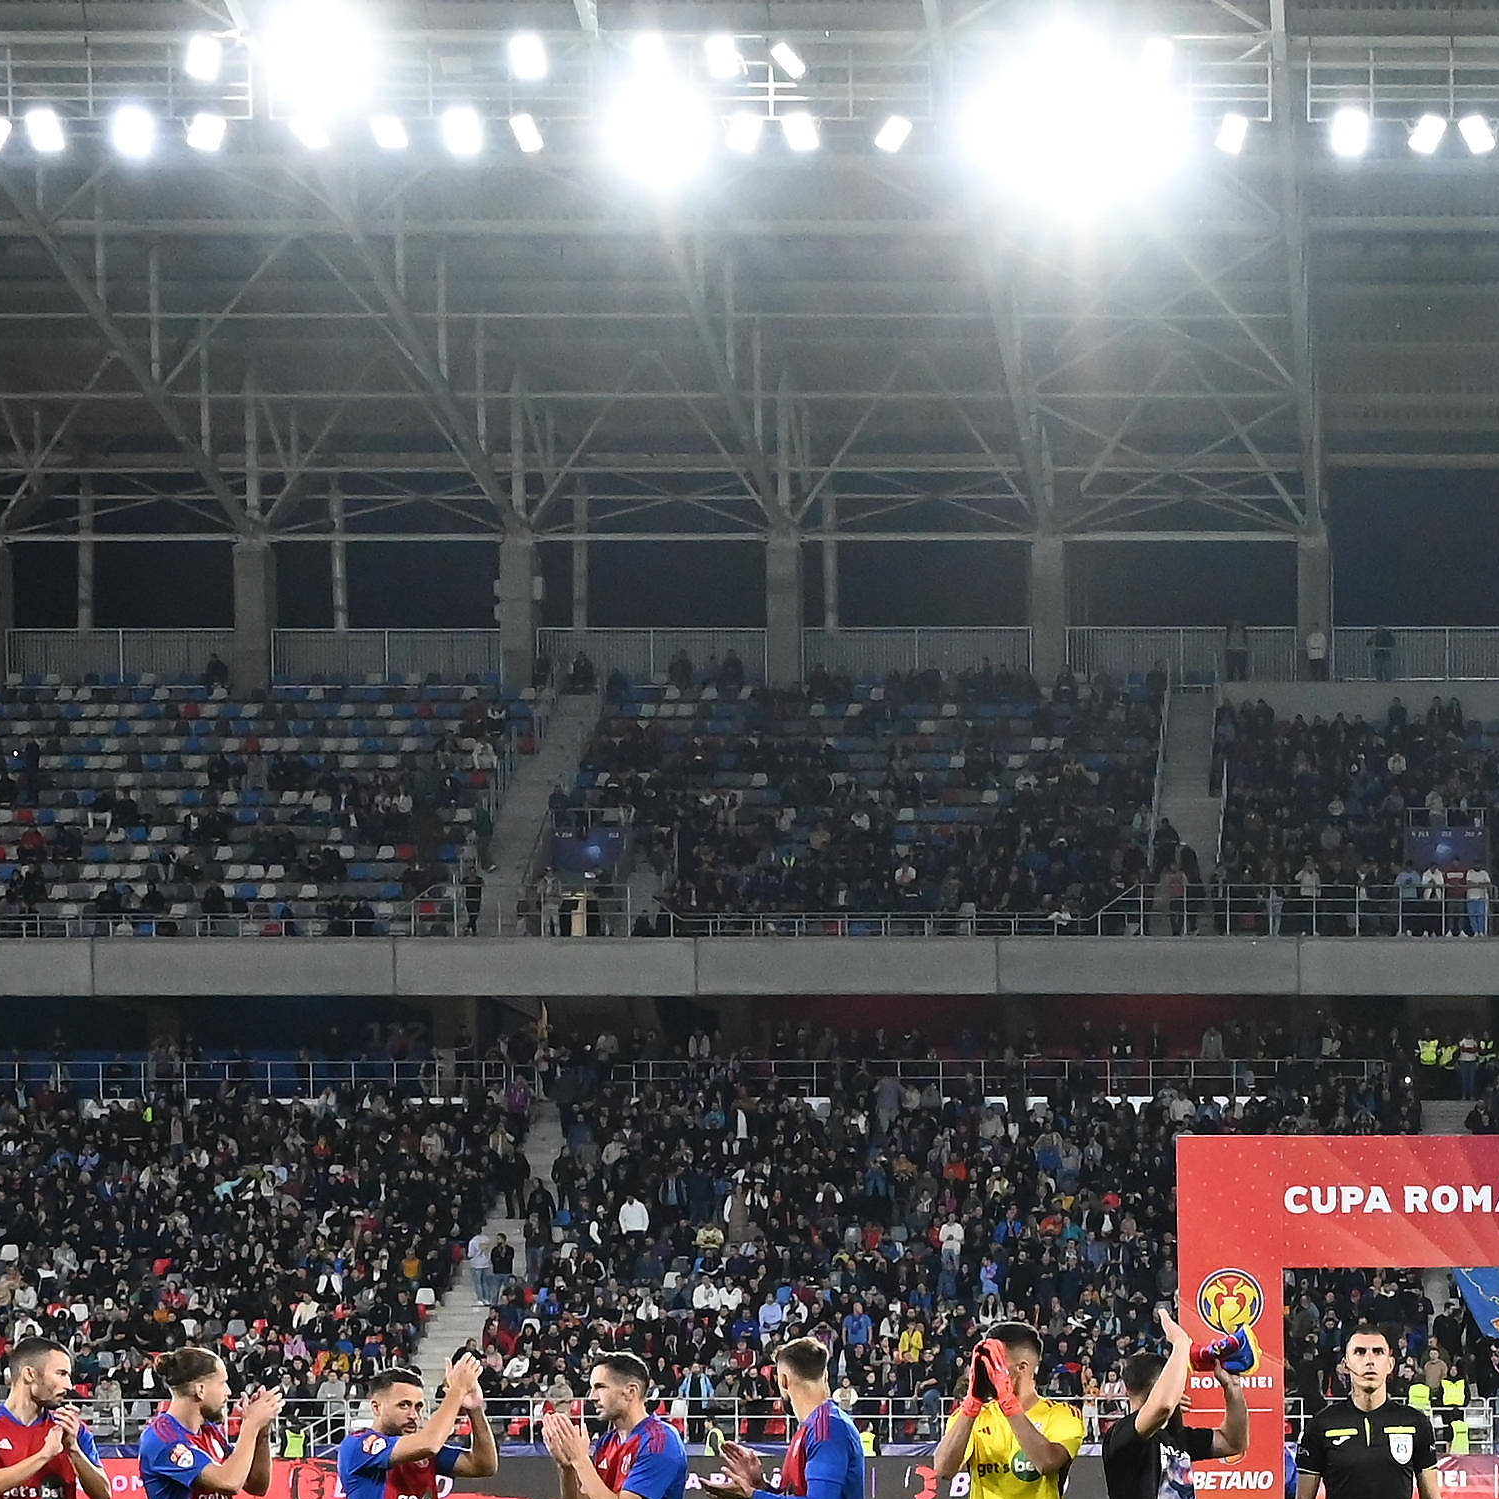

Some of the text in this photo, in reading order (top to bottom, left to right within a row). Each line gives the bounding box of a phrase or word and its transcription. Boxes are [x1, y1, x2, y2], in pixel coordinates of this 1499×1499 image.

[1284, 1186, 1393, 1214] CUPA
[1013, 1459, 1034, 1473] be
[1194, 1471, 1274, 1490] BETANO
